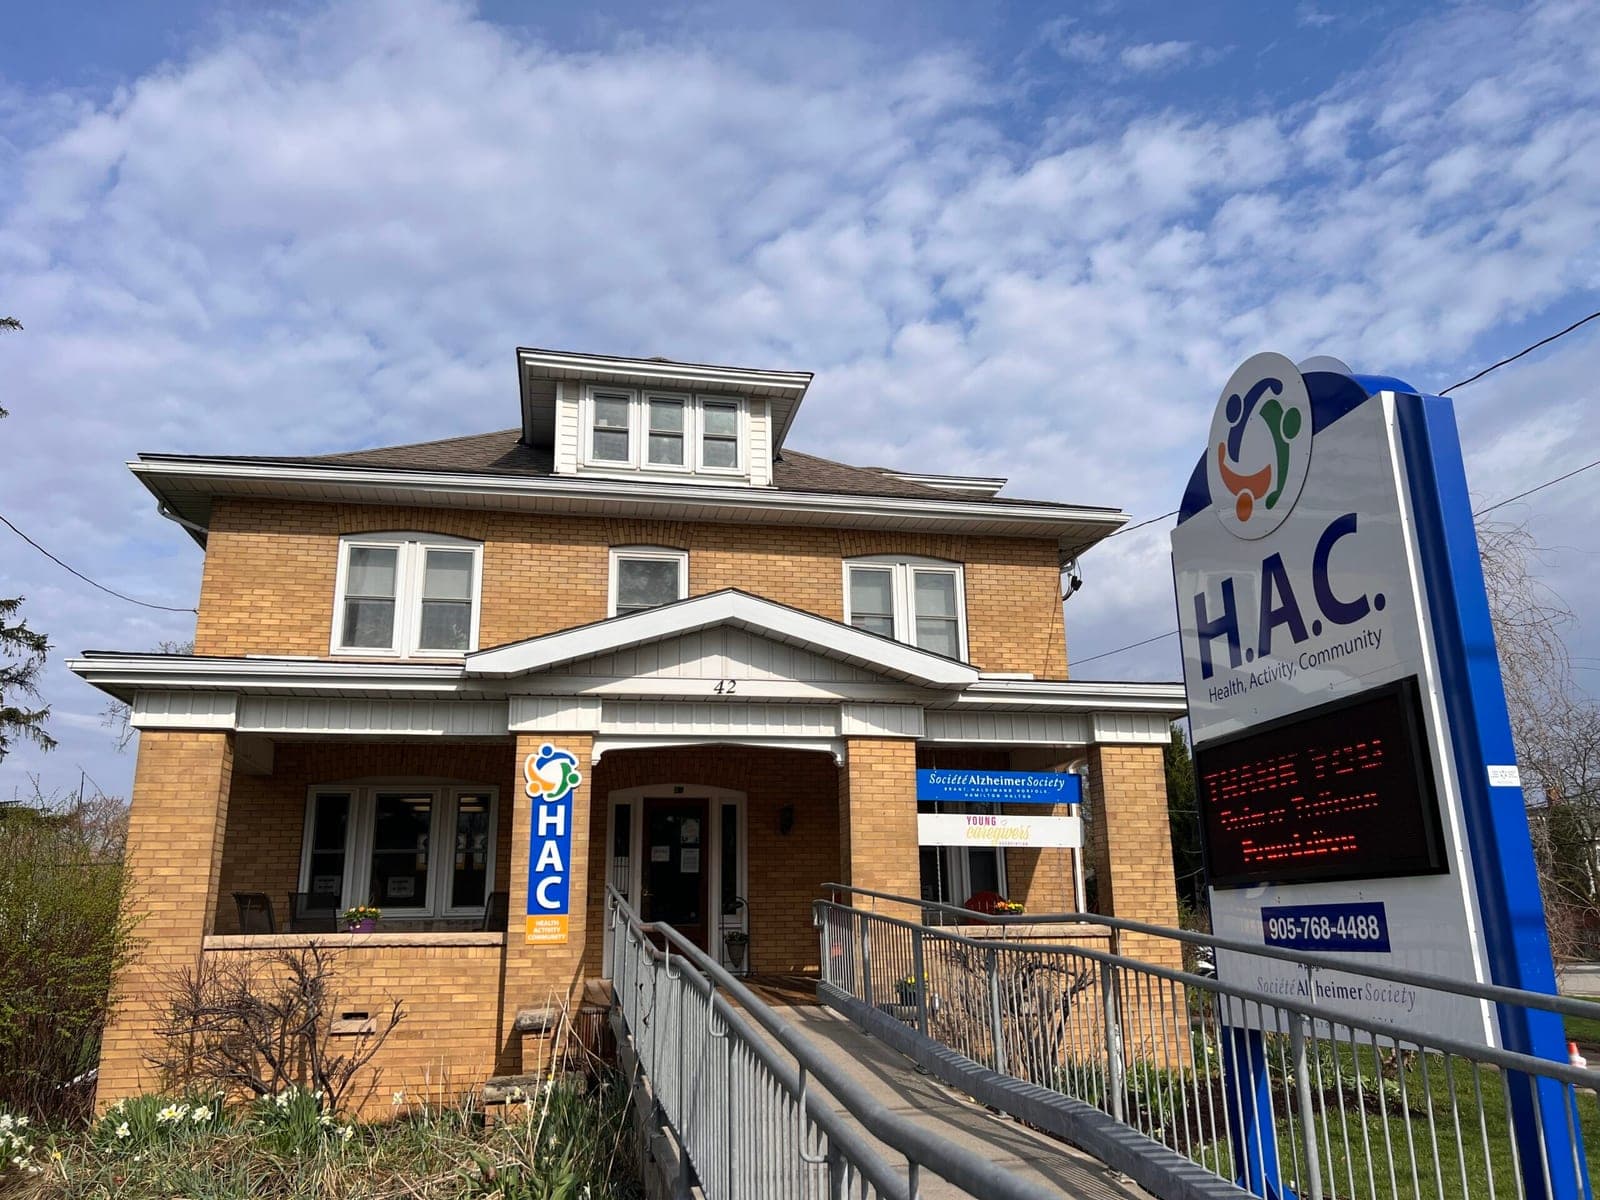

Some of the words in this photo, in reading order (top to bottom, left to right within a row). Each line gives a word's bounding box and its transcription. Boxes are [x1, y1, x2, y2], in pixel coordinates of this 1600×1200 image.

[1194, 512, 1386, 680] H.A.C.
[1208, 679, 1248, 703] Health,
[1249, 661, 1297, 689] Activity,
[1299, 629, 1383, 671] Community
[713, 679, 737, 694] 42
[929, 773, 968, 785] Société
[969, 775, 1026, 786] Alzheimer
[1026, 775, 1065, 792] Society
[966, 815, 997, 826] YOUNG
[1269, 915, 1380, 940] 905-768-4488
[1256, 976, 1296, 995] Société
[1297, 980, 1363, 1001] Alheimer
[1365, 983, 1416, 1013] Society
